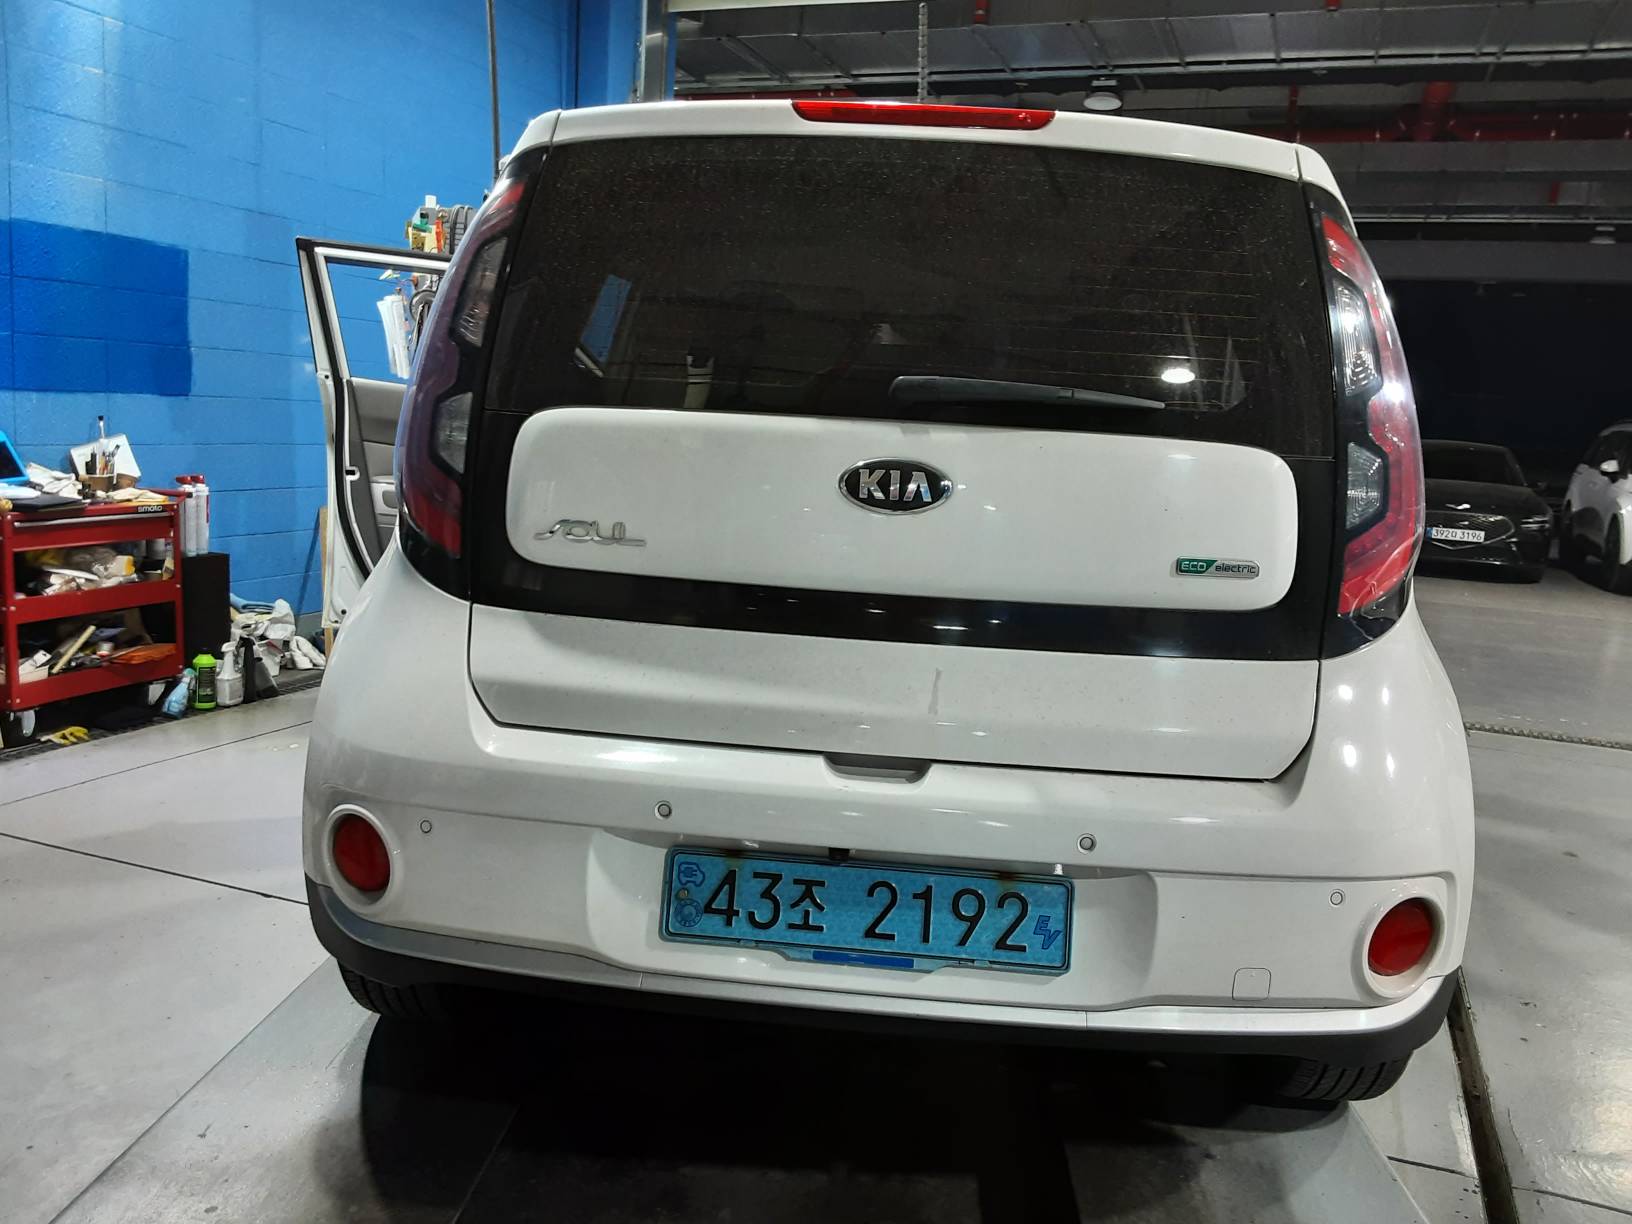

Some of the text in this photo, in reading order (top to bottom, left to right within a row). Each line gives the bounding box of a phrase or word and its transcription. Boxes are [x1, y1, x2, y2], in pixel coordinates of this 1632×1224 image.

[858, 468, 932, 502] KIA
[1181, 561, 1256, 574] ECO electric
[704, 868, 826, 933] 43조
[864, 881, 1029, 953] 2192
[1033, 914, 1061, 950] EV
